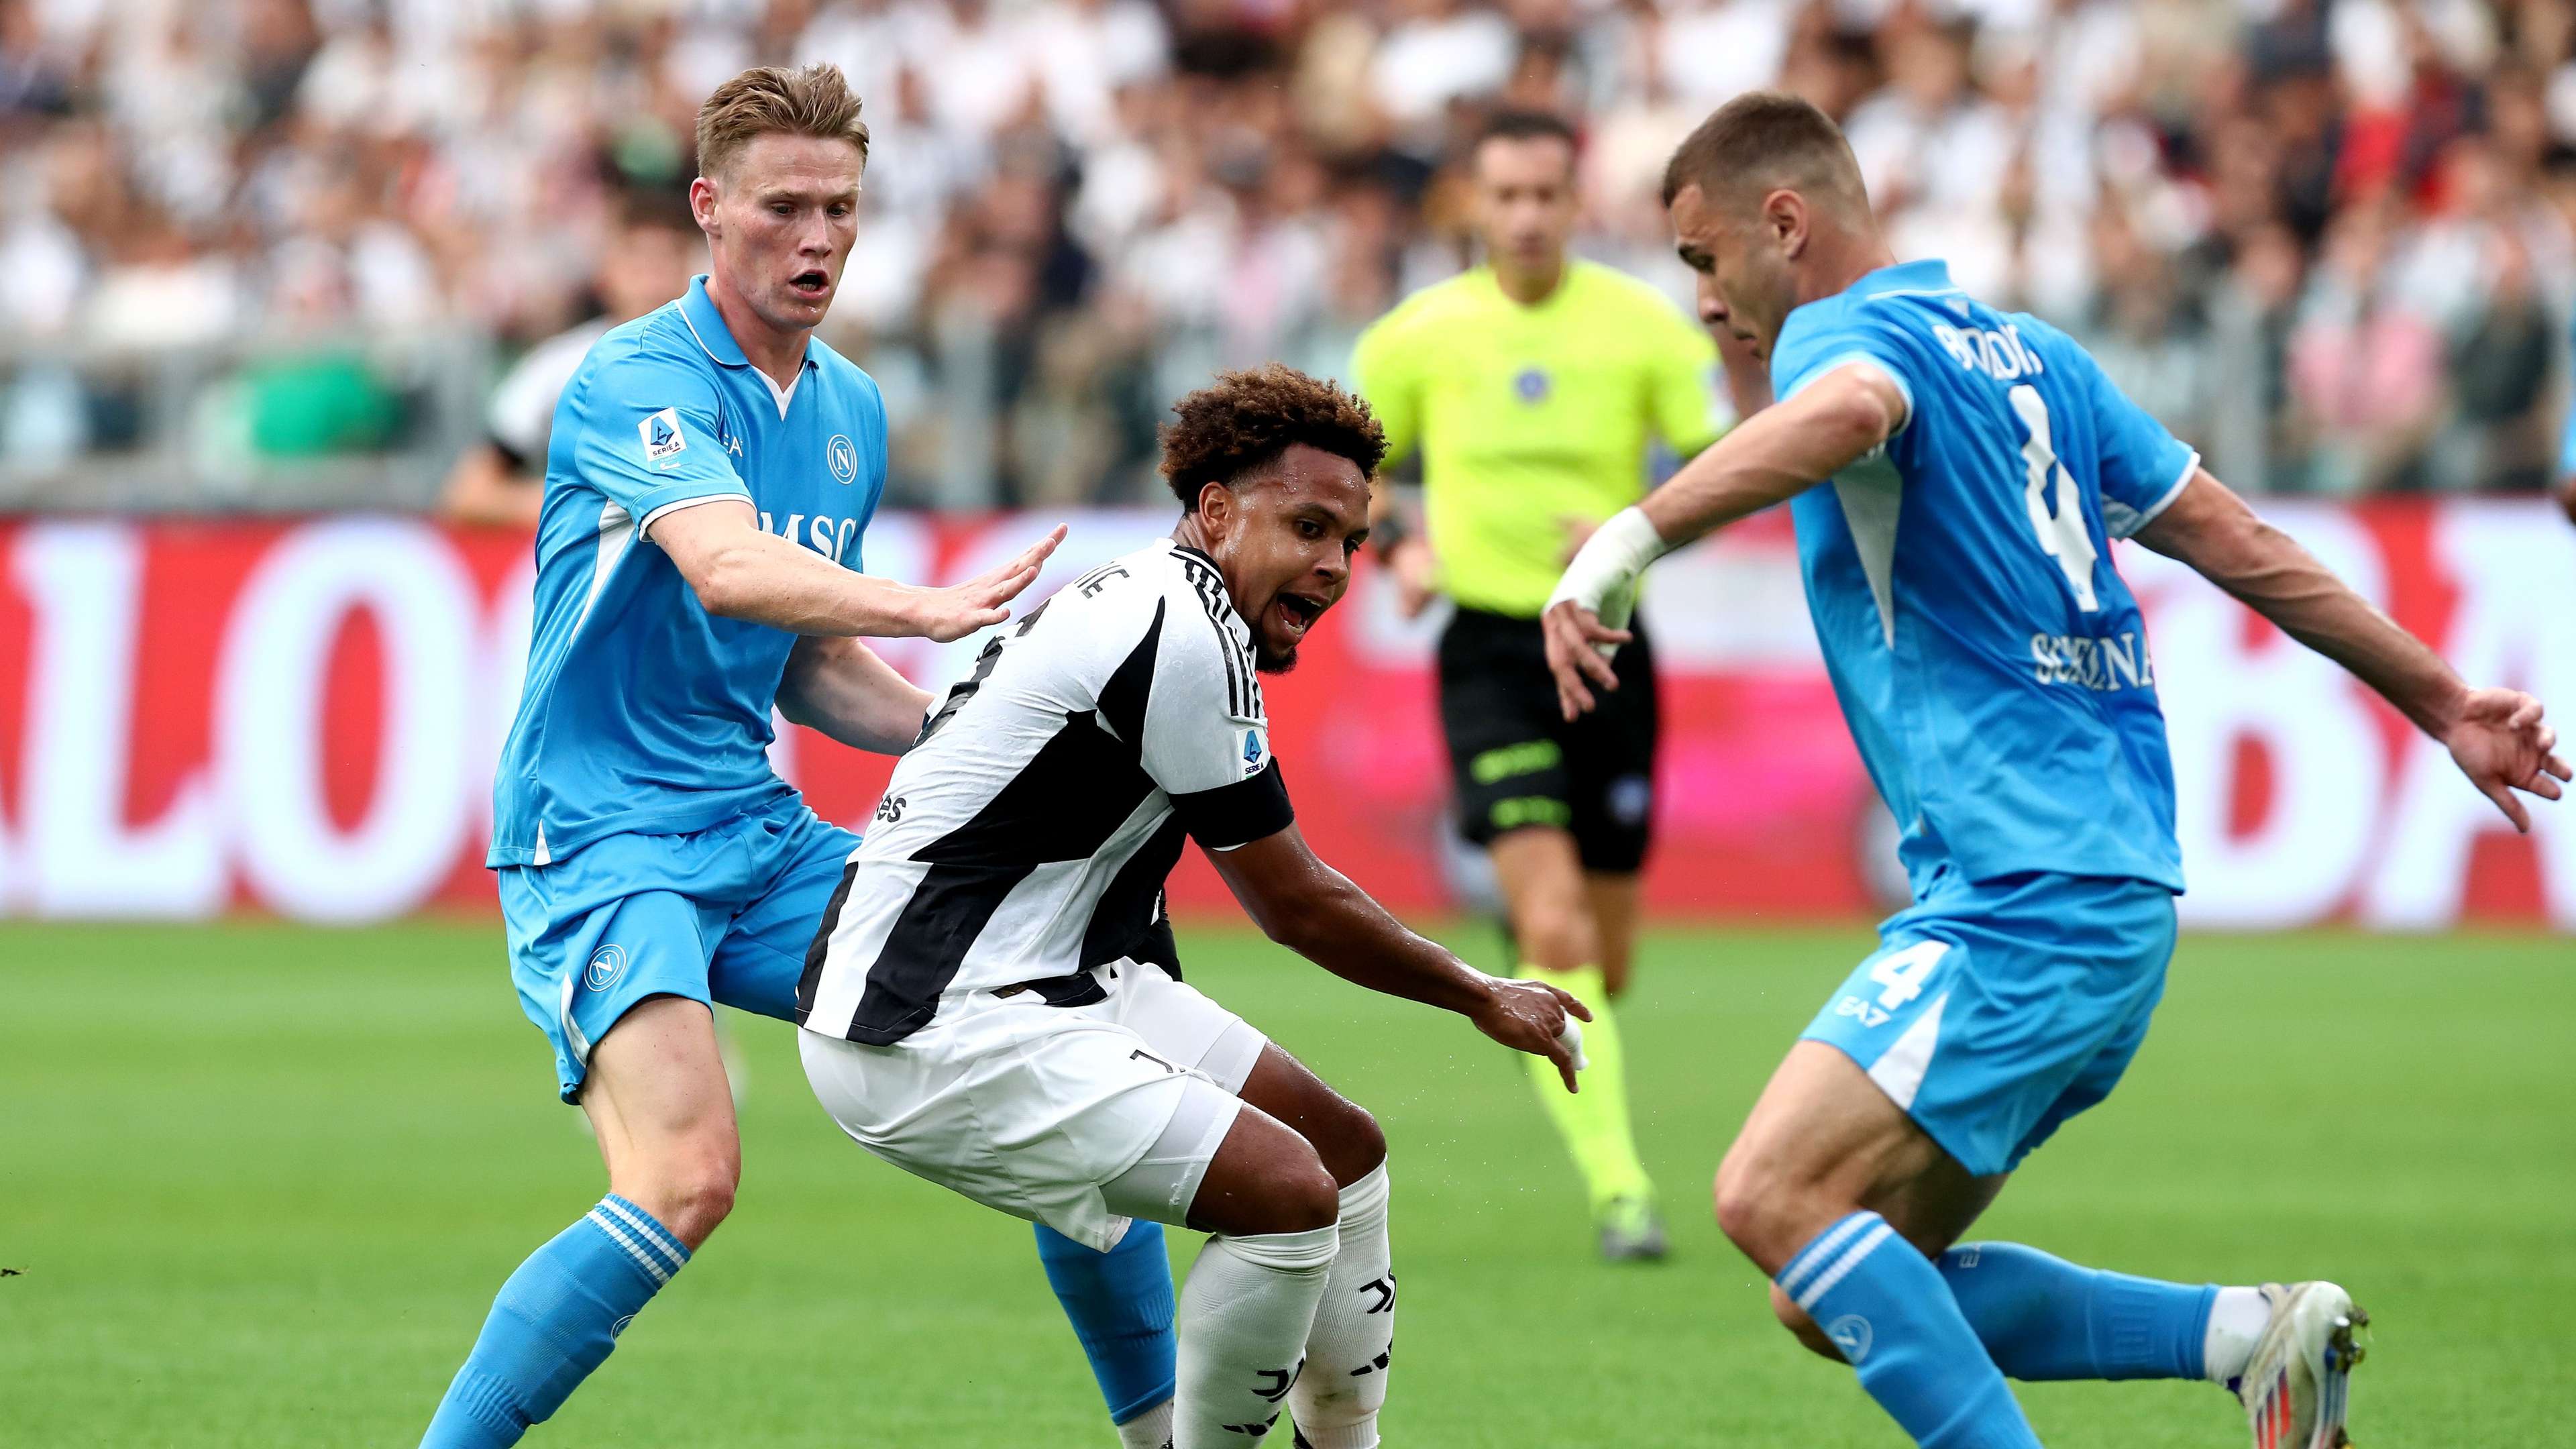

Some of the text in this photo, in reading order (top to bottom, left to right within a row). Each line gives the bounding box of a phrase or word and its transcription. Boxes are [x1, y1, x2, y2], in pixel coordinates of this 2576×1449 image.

[652, 443, 674, 456] SERIE
[2008, 384, 2099, 612] 4
[1245, 763, 1260, 775] SERIE
[1870, 940, 1951, 1011] 4
